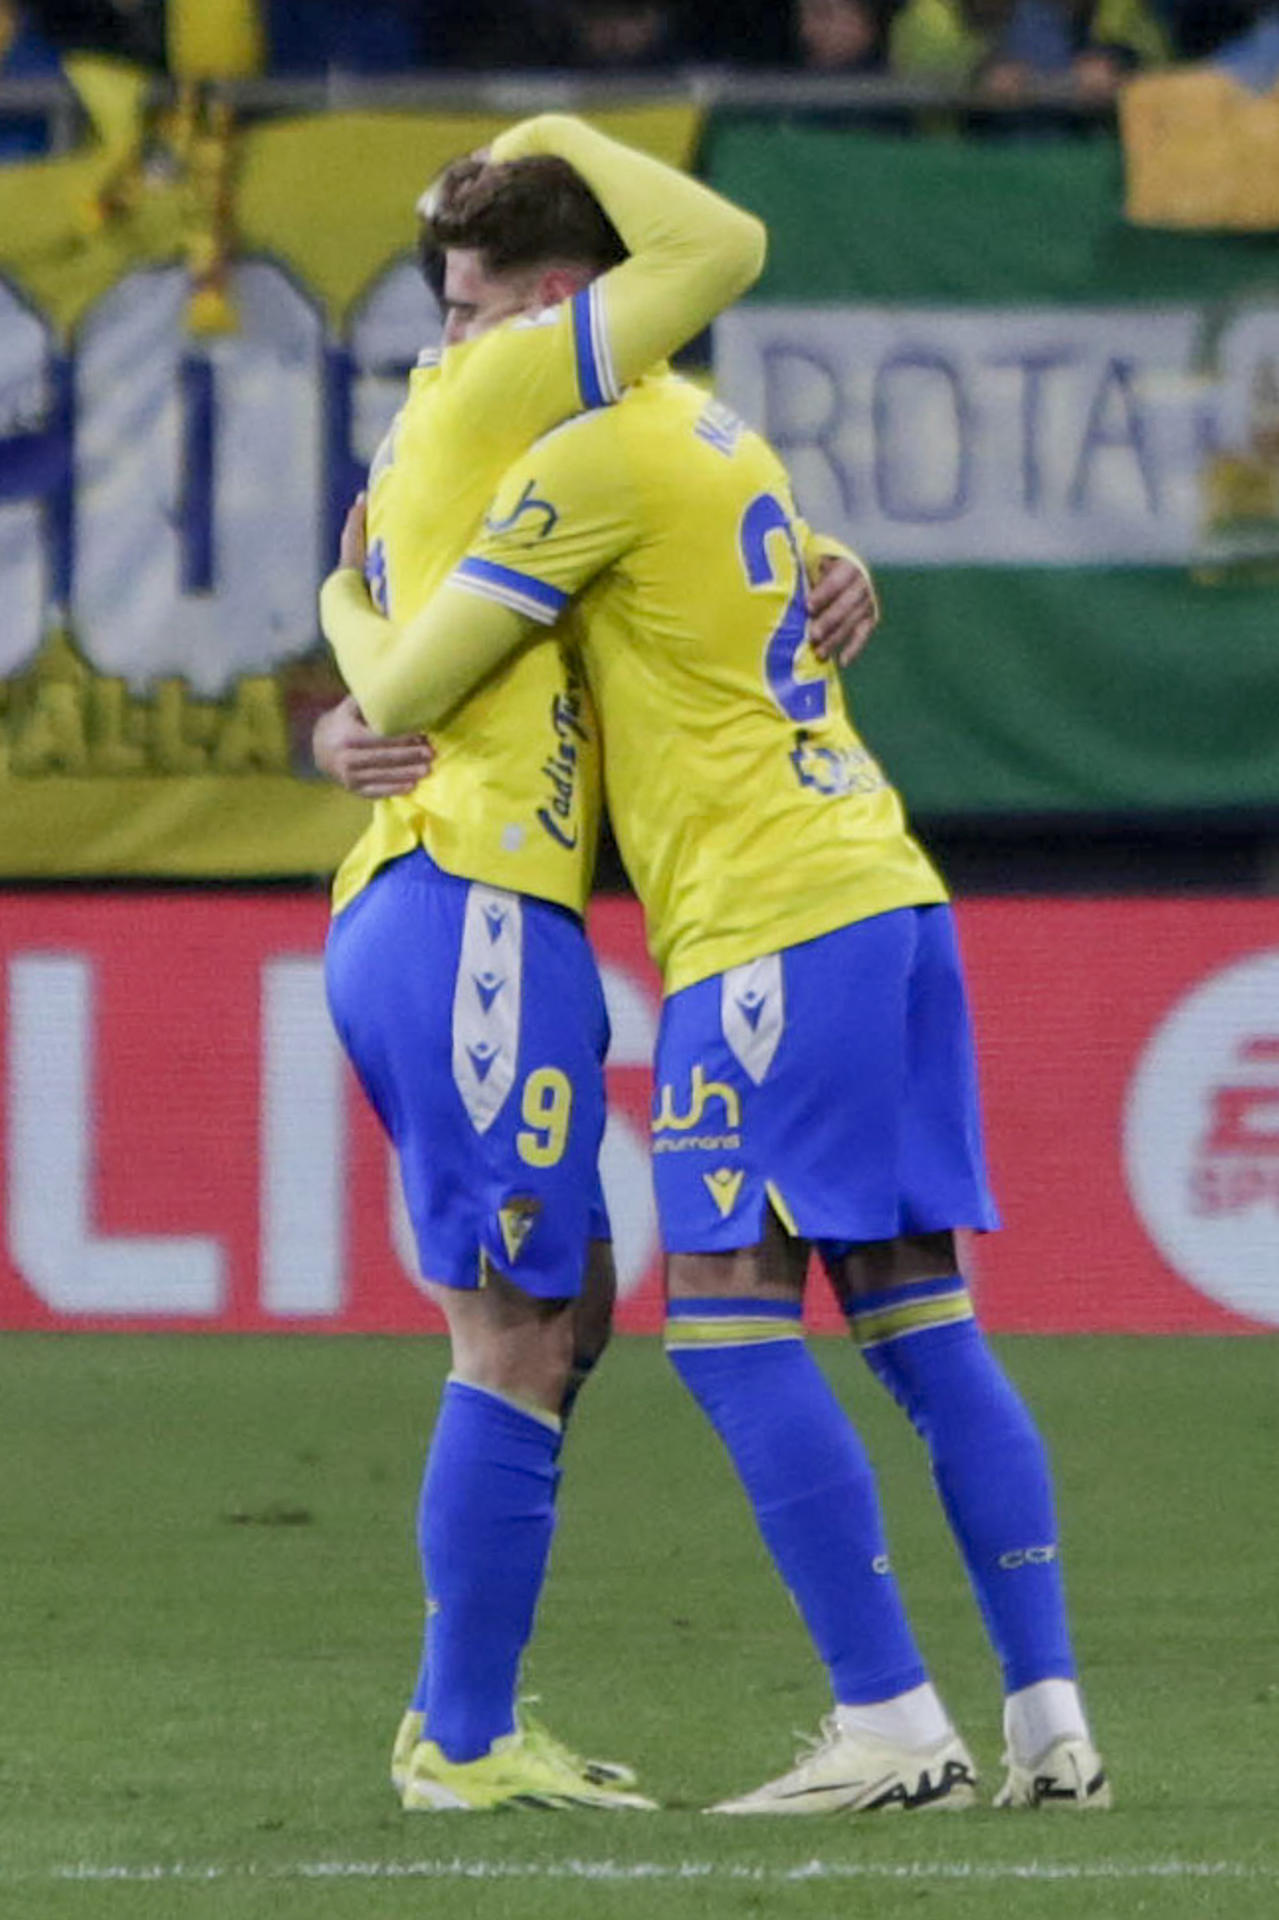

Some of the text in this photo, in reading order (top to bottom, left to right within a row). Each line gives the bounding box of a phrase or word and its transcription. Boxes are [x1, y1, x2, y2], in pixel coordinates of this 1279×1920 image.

[761, 335, 1162, 523] ROTA
[2, 676, 286, 777] ALLA
[517, 1067, 572, 1168] 9
